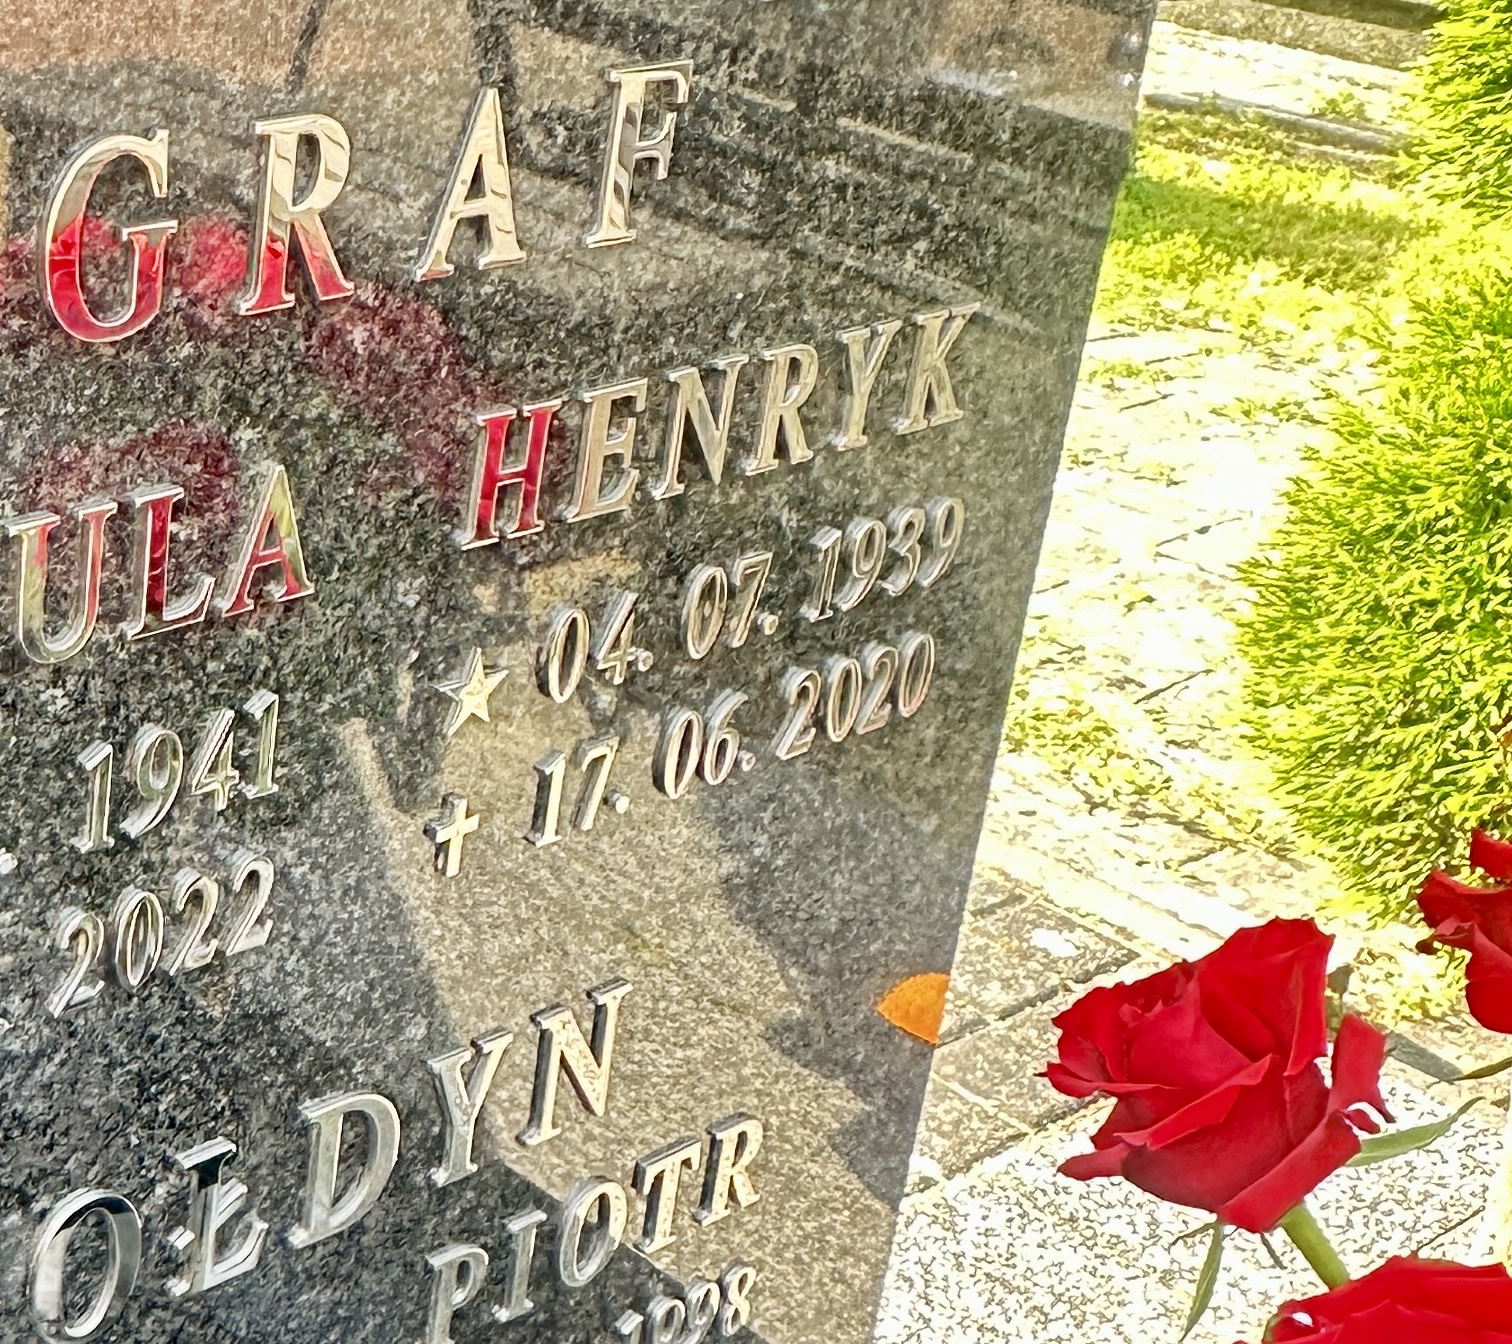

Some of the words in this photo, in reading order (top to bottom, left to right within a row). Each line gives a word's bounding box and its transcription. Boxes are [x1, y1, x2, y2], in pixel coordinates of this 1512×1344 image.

[44, 59, 693, 343] GRAF
[460, 302, 982, 550] HENRYK
[683, 552, 779, 659] 07.
[809, 497, 966, 623] 1939
[74, 690, 280, 854] 1941
[524, 735, 630, 848] 17.
[654, 690, 755, 799] 06.
[774, 631, 935, 760] 2020
[50, 848, 275, 1019] 2022
